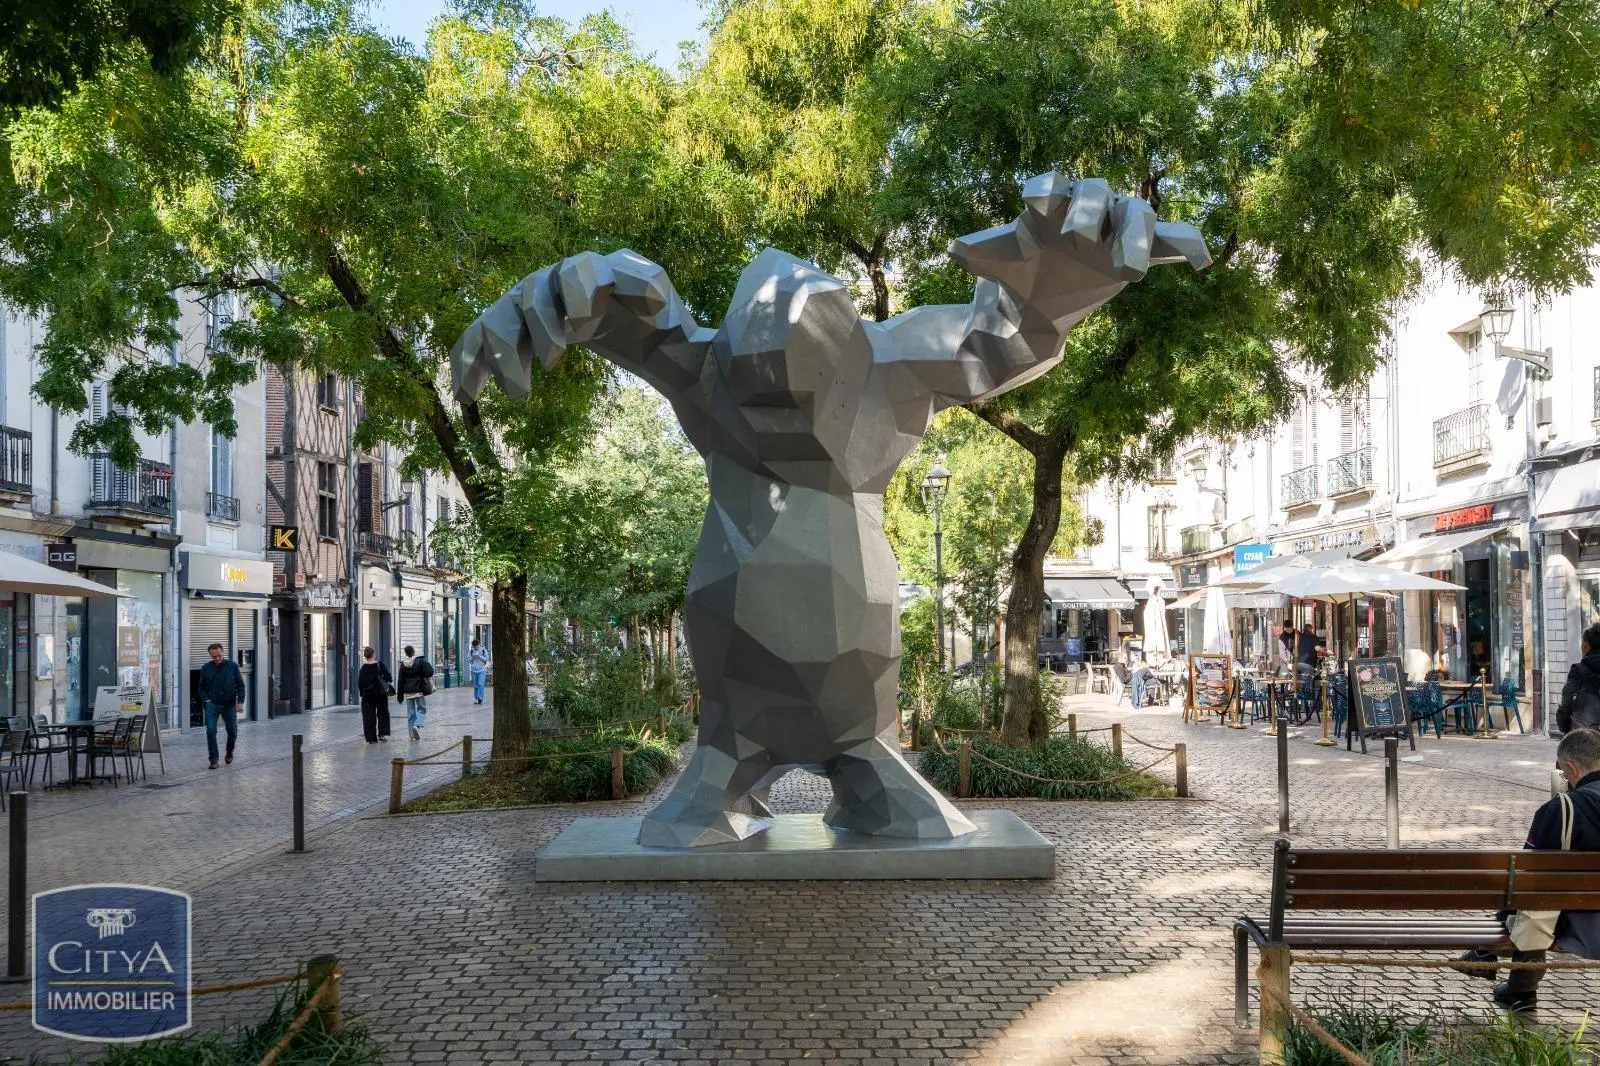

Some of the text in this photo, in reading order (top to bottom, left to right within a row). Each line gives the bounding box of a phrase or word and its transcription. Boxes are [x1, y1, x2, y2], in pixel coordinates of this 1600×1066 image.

[278, 528, 295, 549] K
[49, 552, 75, 562] QG
[1243, 552, 1263, 561] CESAR
